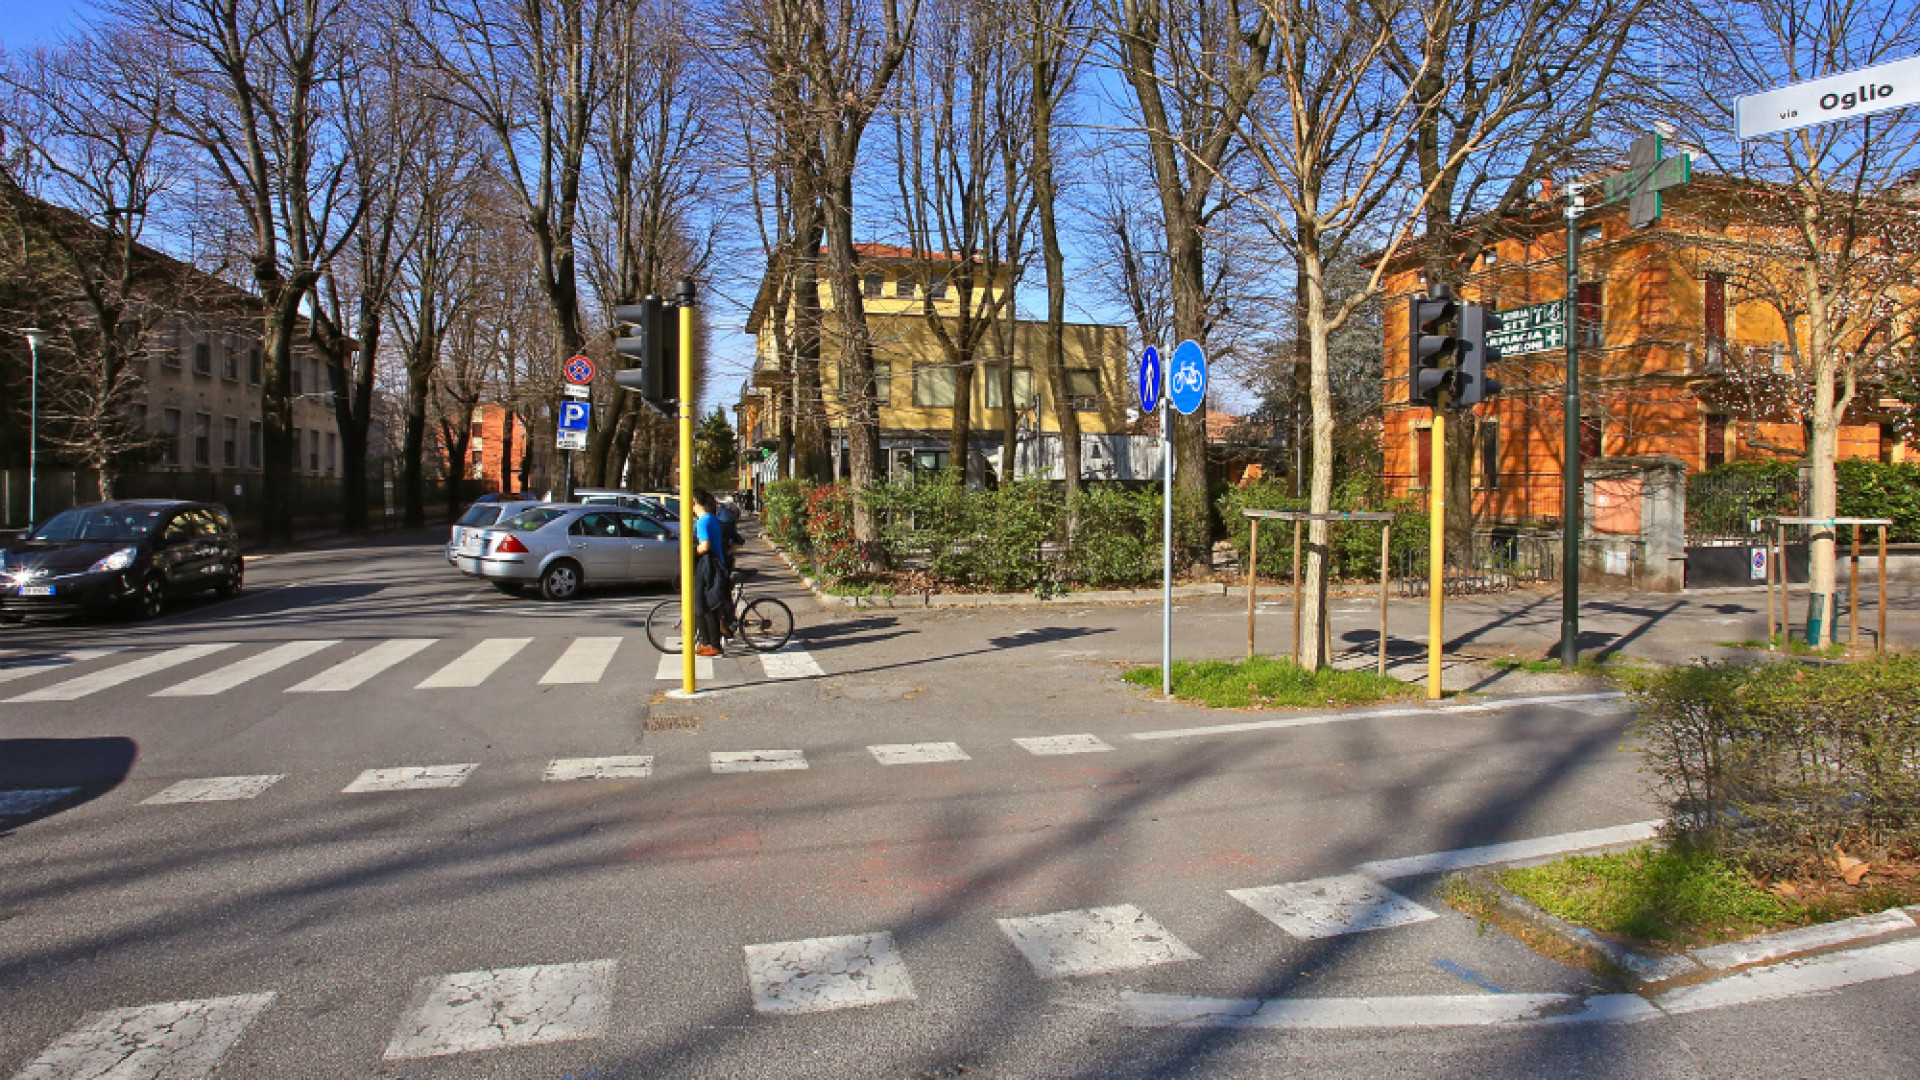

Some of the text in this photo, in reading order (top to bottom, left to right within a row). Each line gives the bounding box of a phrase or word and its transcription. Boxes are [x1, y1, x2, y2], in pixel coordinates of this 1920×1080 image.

[1779, 83, 1894, 120] via Oglio
[564, 404, 584, 427] P
